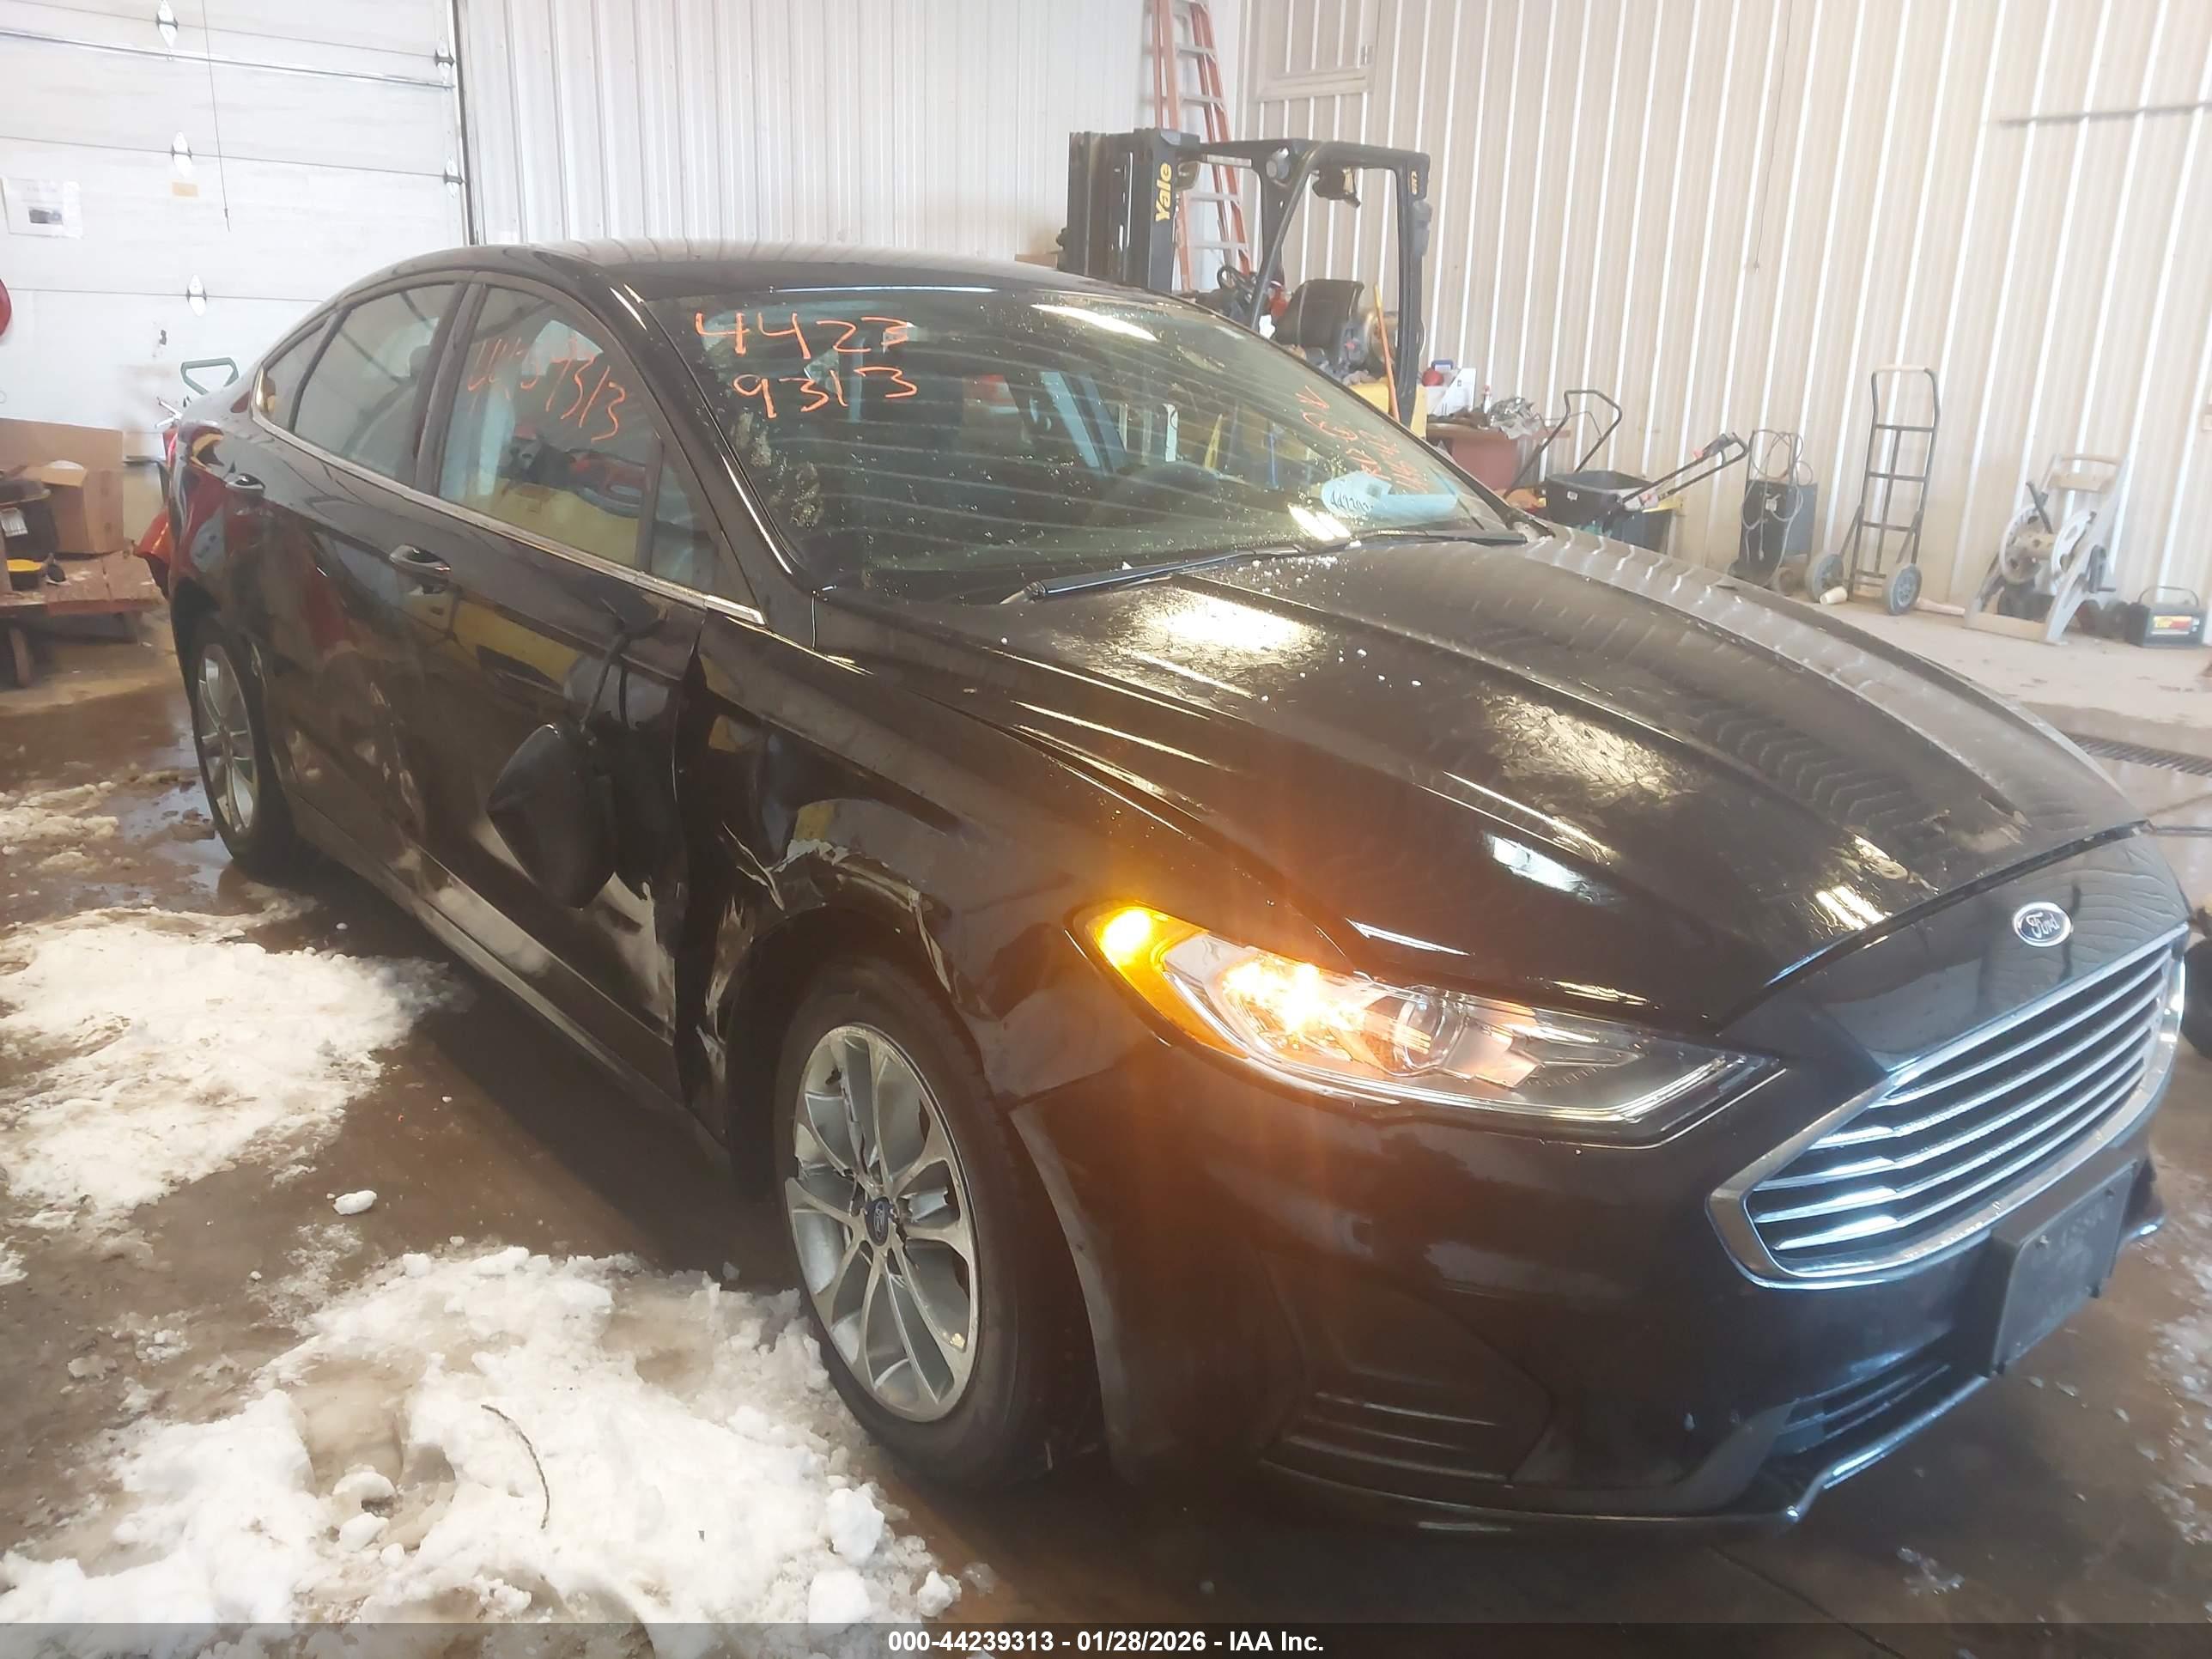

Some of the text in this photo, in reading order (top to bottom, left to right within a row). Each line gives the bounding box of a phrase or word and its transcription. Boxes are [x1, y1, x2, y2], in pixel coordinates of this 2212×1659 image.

[1155, 161, 1172, 222] Yale
[732, 366, 919, 419] 9313
[2026, 911, 2060, 939] Ford
